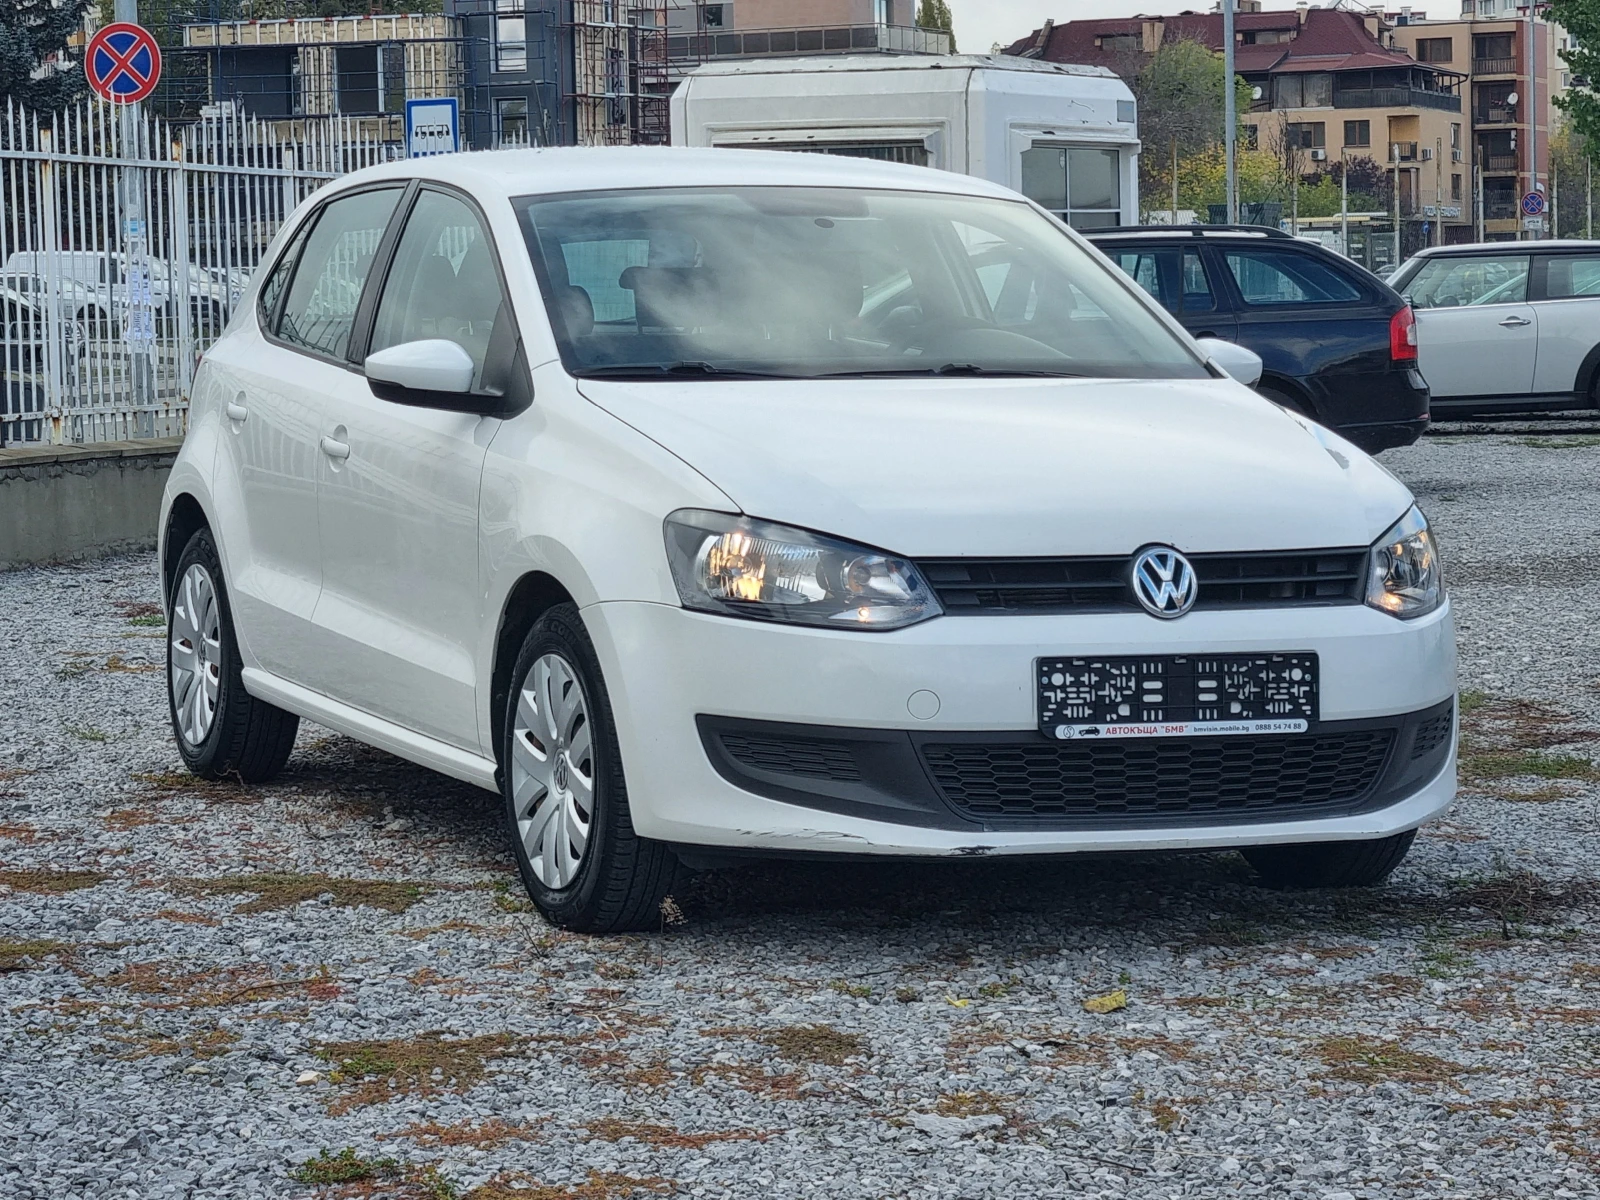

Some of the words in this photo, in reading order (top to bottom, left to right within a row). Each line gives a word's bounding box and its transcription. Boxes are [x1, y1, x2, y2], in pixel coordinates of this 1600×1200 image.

[1105, 726, 1158, 735] АВТОКЪЩА
[1161, 724, 1189, 734] "БМВ"
[1193, 725, 1250, 733] bmvisin.mobile.bg
[1255, 723, 1272, 731] 0888
[1293, 722, 1302, 730] 88
